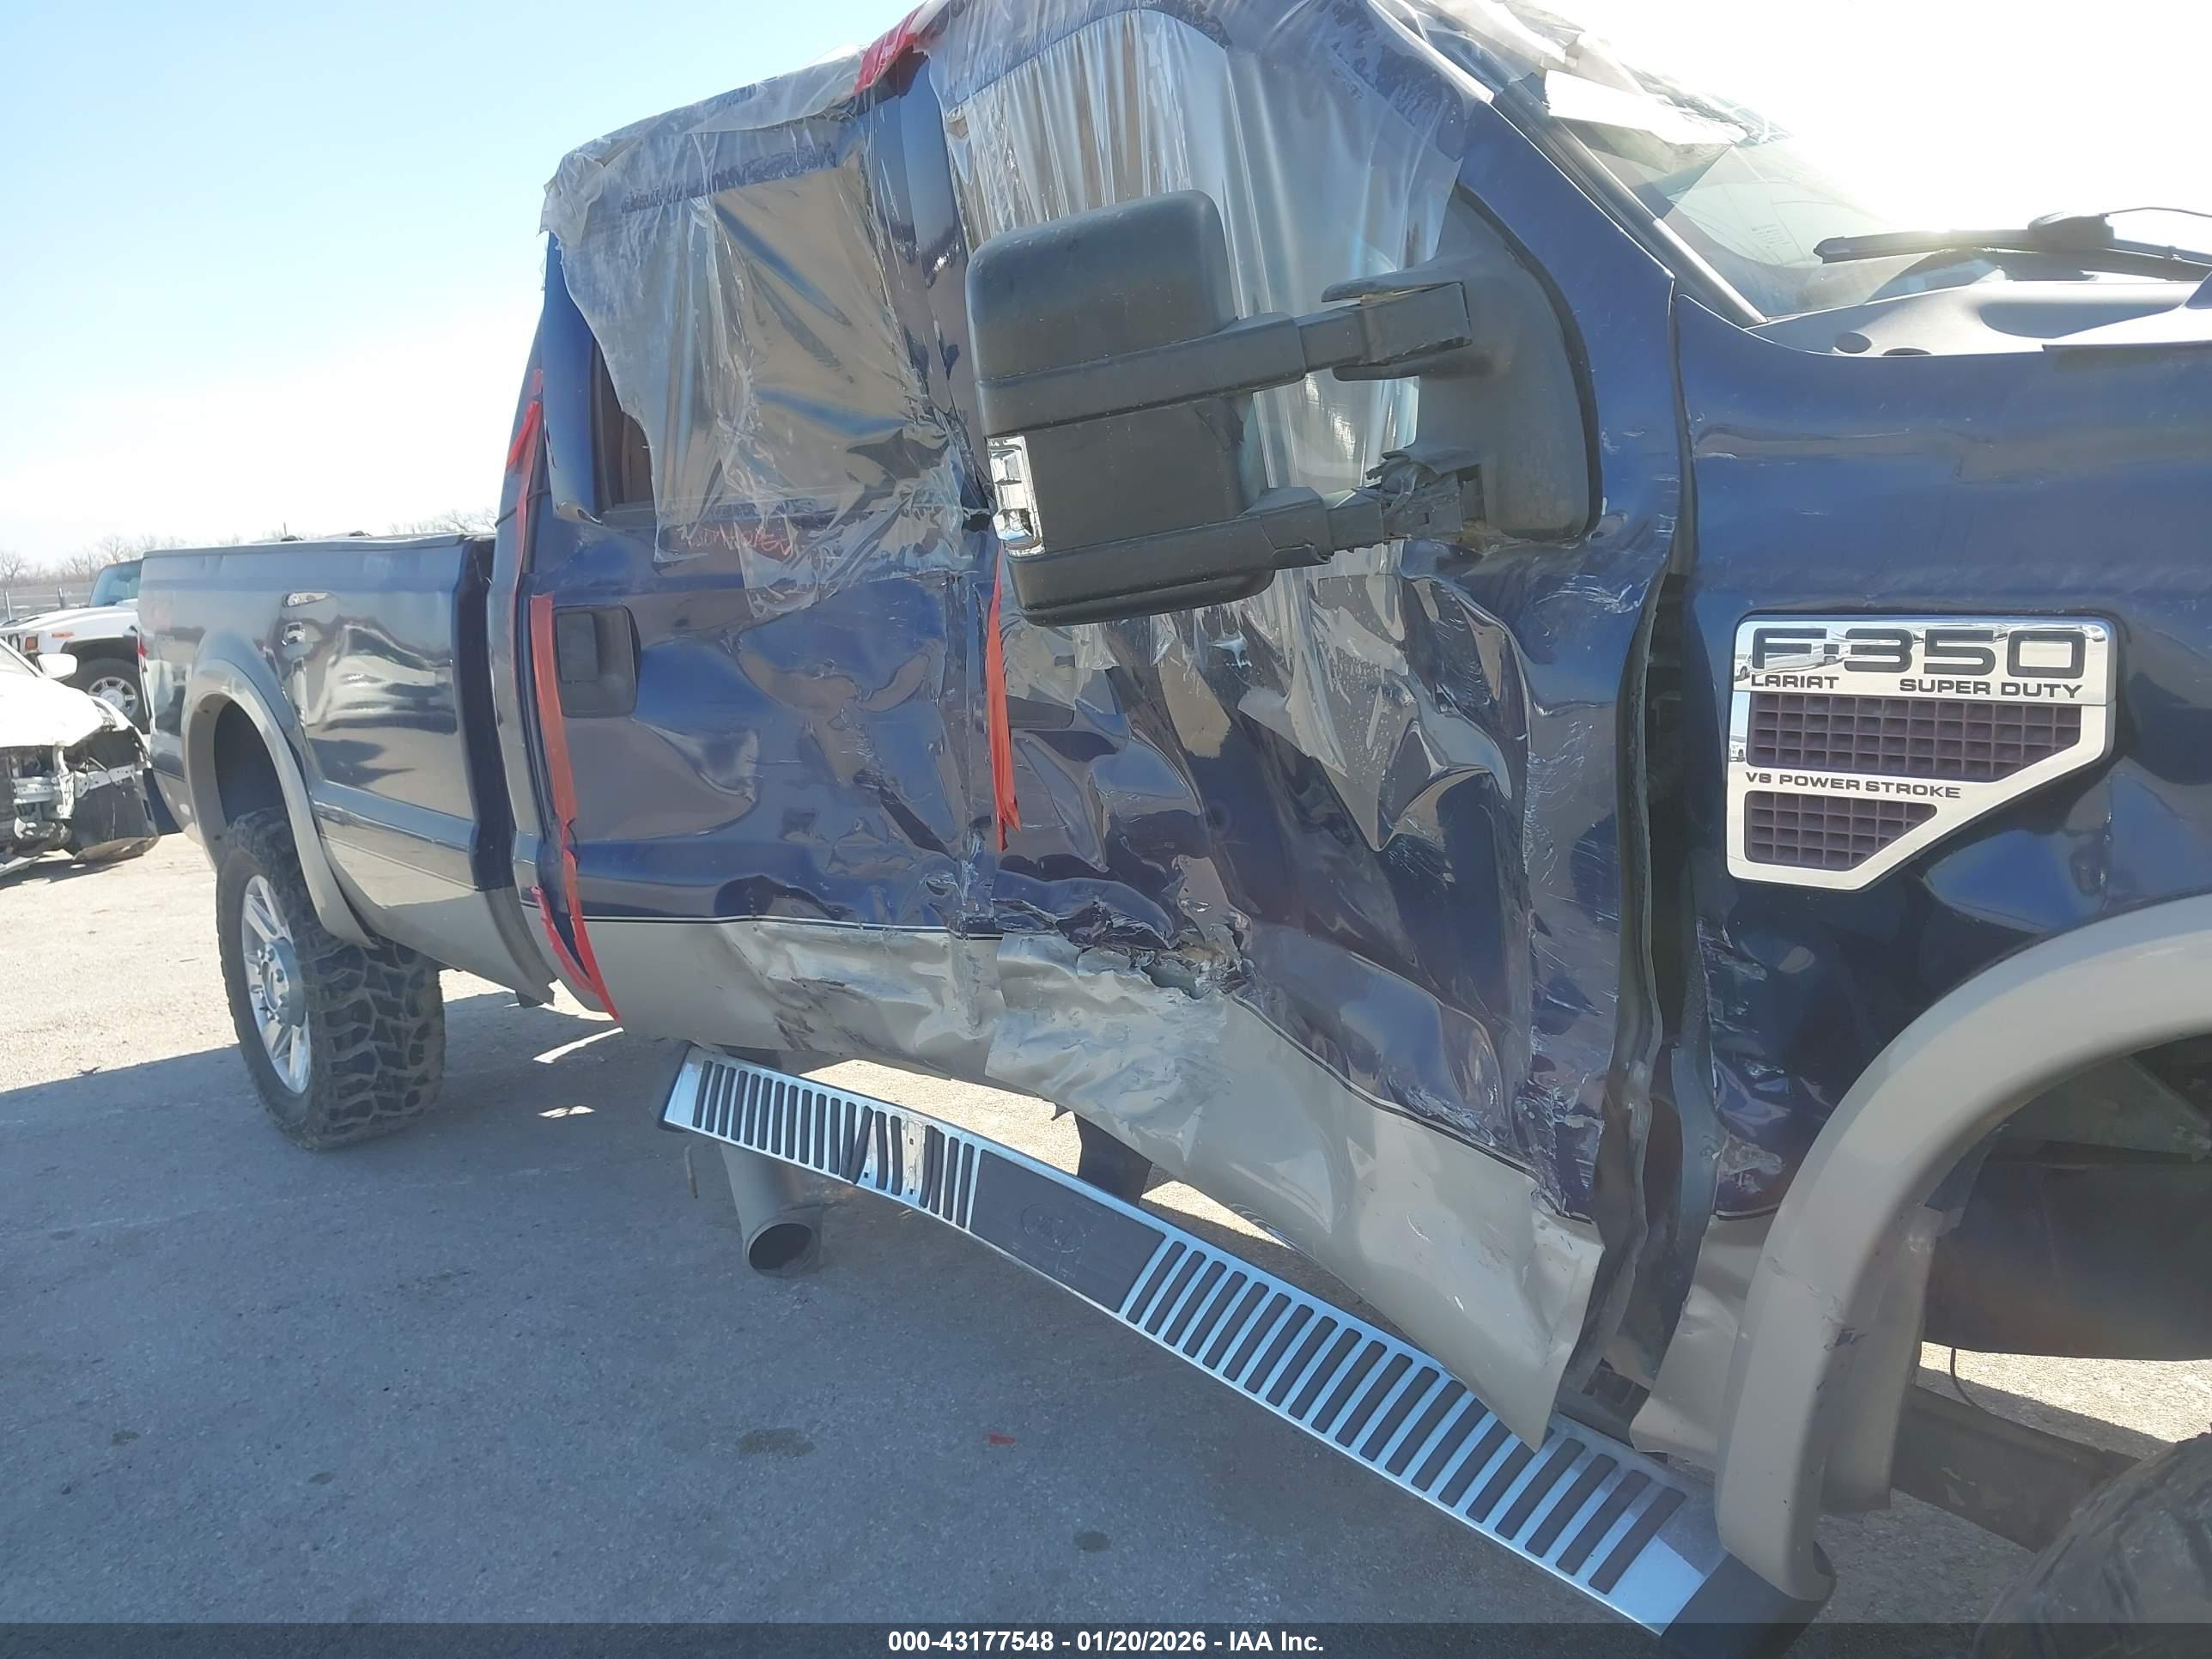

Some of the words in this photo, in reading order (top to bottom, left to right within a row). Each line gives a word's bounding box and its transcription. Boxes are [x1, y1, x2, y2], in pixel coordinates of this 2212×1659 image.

[1751, 628, 2087, 679] F-350
[1751, 674, 1840, 690] LARIAT
[1899, 678, 1991, 697] SUPER
[2000, 682, 2083, 699] DUTY
[1745, 771, 1771, 785] V8
[1778, 774, 1861, 792] POWER
[1864, 780, 1961, 799] STROKE
